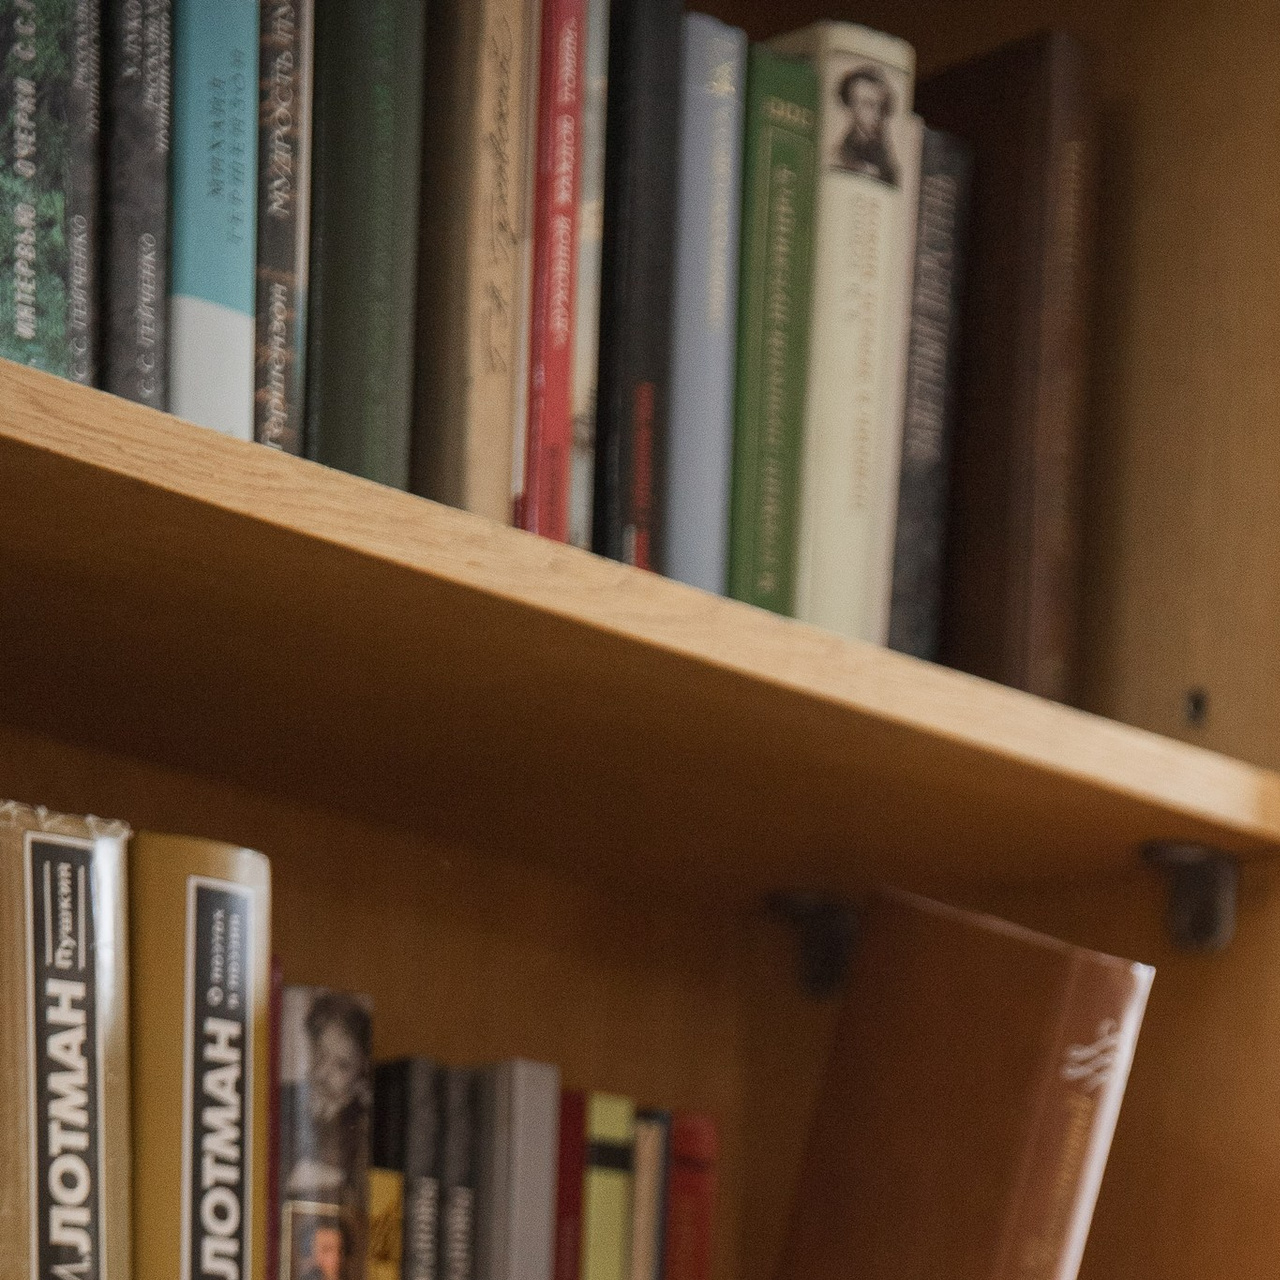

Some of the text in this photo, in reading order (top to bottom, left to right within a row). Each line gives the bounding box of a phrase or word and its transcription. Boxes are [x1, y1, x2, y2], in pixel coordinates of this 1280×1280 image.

[14, 77, 35, 177] ОЧЕРКИ
[207, 76, 226, 200] МИХАИЛ
[227, 47, 245, 246] ГЕРШЕНЗОН
[266, 50, 294, 218] МУДРОСТЬ
[14, 203, 36, 339] ИНТЕРВЬЮ
[70, 214, 88, 330] ГЕЙЧЕНКО
[138, 232, 157, 346] ГЕЙЧЕНКО
[262, 282, 288, 450] Гершензон
[55, 862, 76, 969] Пушкин
